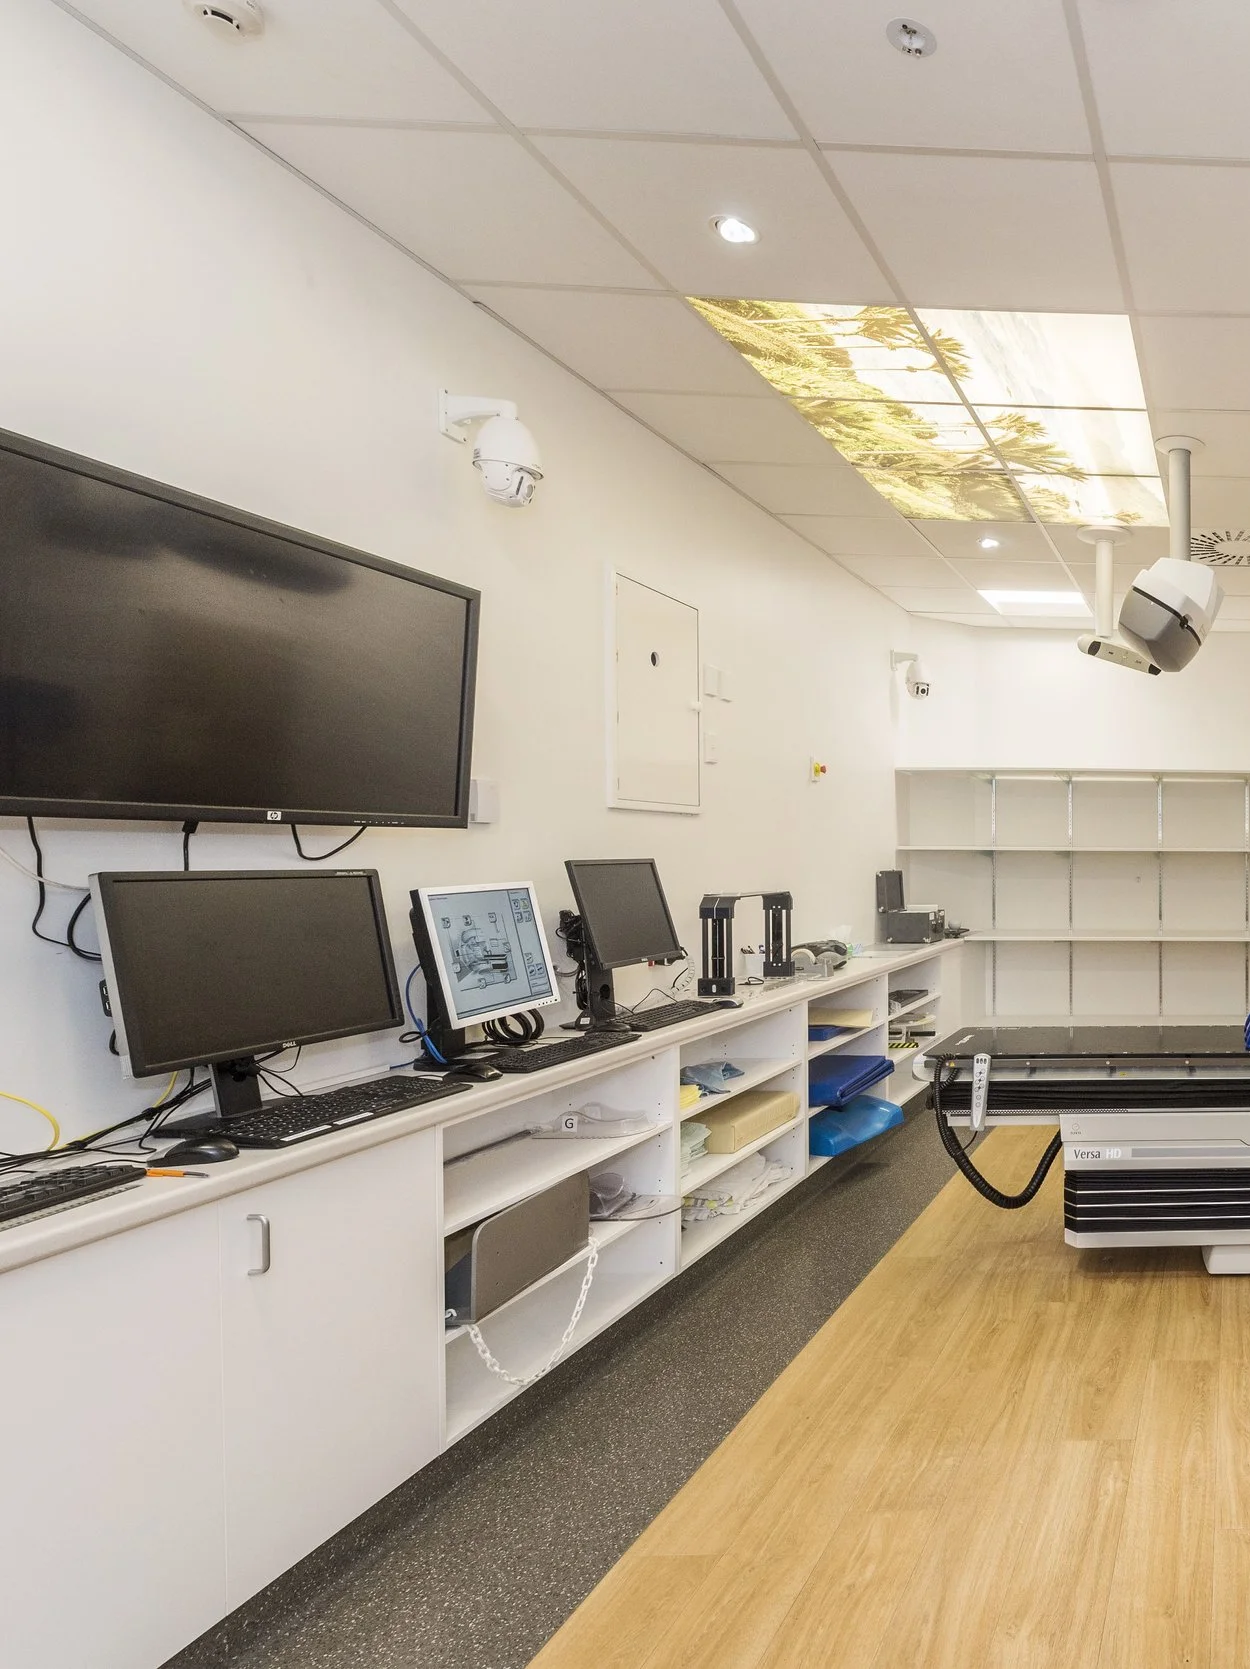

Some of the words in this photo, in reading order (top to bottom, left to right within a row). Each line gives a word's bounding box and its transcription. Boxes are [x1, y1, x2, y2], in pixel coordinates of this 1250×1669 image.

[282, 1041, 297, 1049] DELL
[565, 1118, 574, 1129] G
[1073, 1149, 1101, 1159] Versa
[1105, 1148, 1122, 1159] HD
